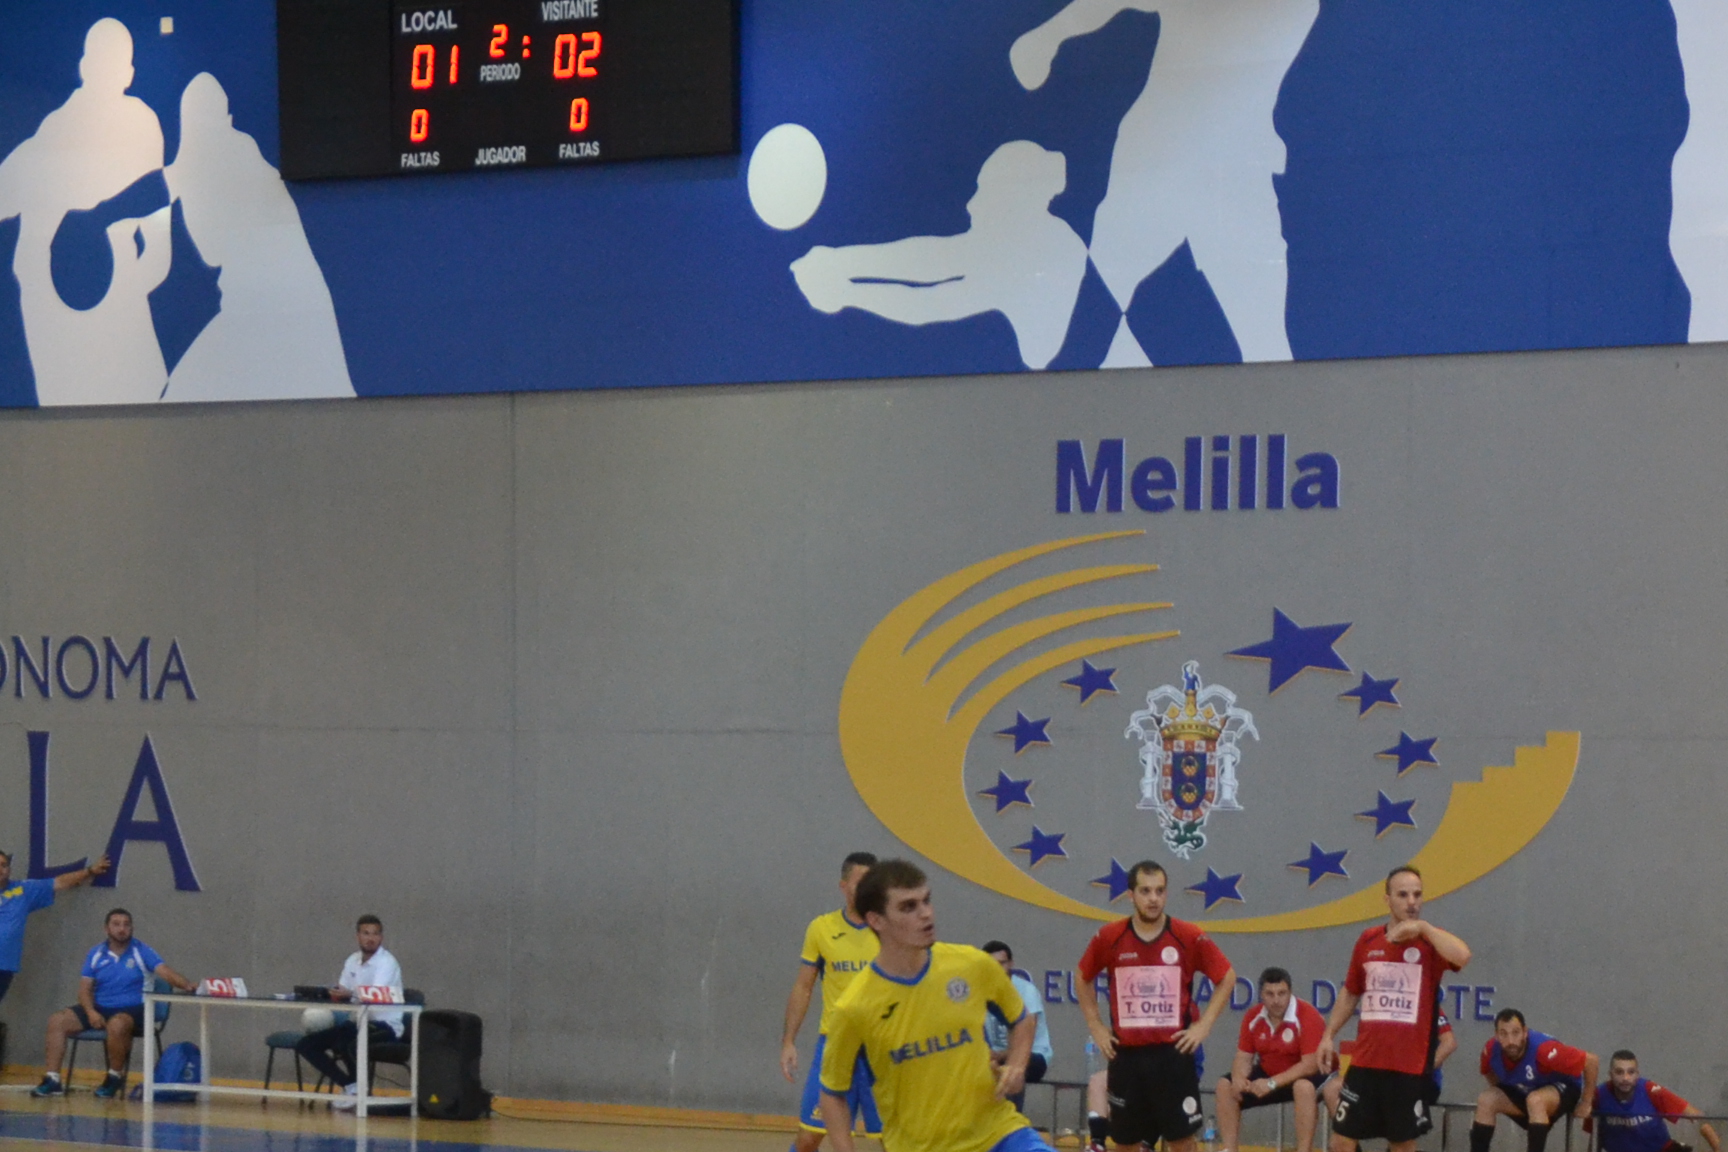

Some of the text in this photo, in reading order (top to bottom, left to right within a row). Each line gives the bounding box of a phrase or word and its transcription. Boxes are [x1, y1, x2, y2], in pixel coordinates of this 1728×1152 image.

[401, 10, 458, 32] LOCAL
[541, 0, 599, 21] VISITANTE
[553, 31, 602, 79] 02
[411, 44, 459, 89] 01
[480, 63, 521, 82] PERIODO
[410, 108, 430, 142] 0
[569, 97, 589, 132] 0
[401, 151, 441, 168] FALTAS
[474, 145, 527, 166] JUGADOR
[558, 141, 600, 159] FALTAS
[1055, 433, 1341, 514] Melilla
[0, 635, 197, 700] NOMA
[831, 960, 867, 972] MELI
[1141, 1001, 1174, 1014] Ortiz
[1379, 995, 1412, 1009] Ortiz
[889, 1028, 973, 1064] MELILLA
